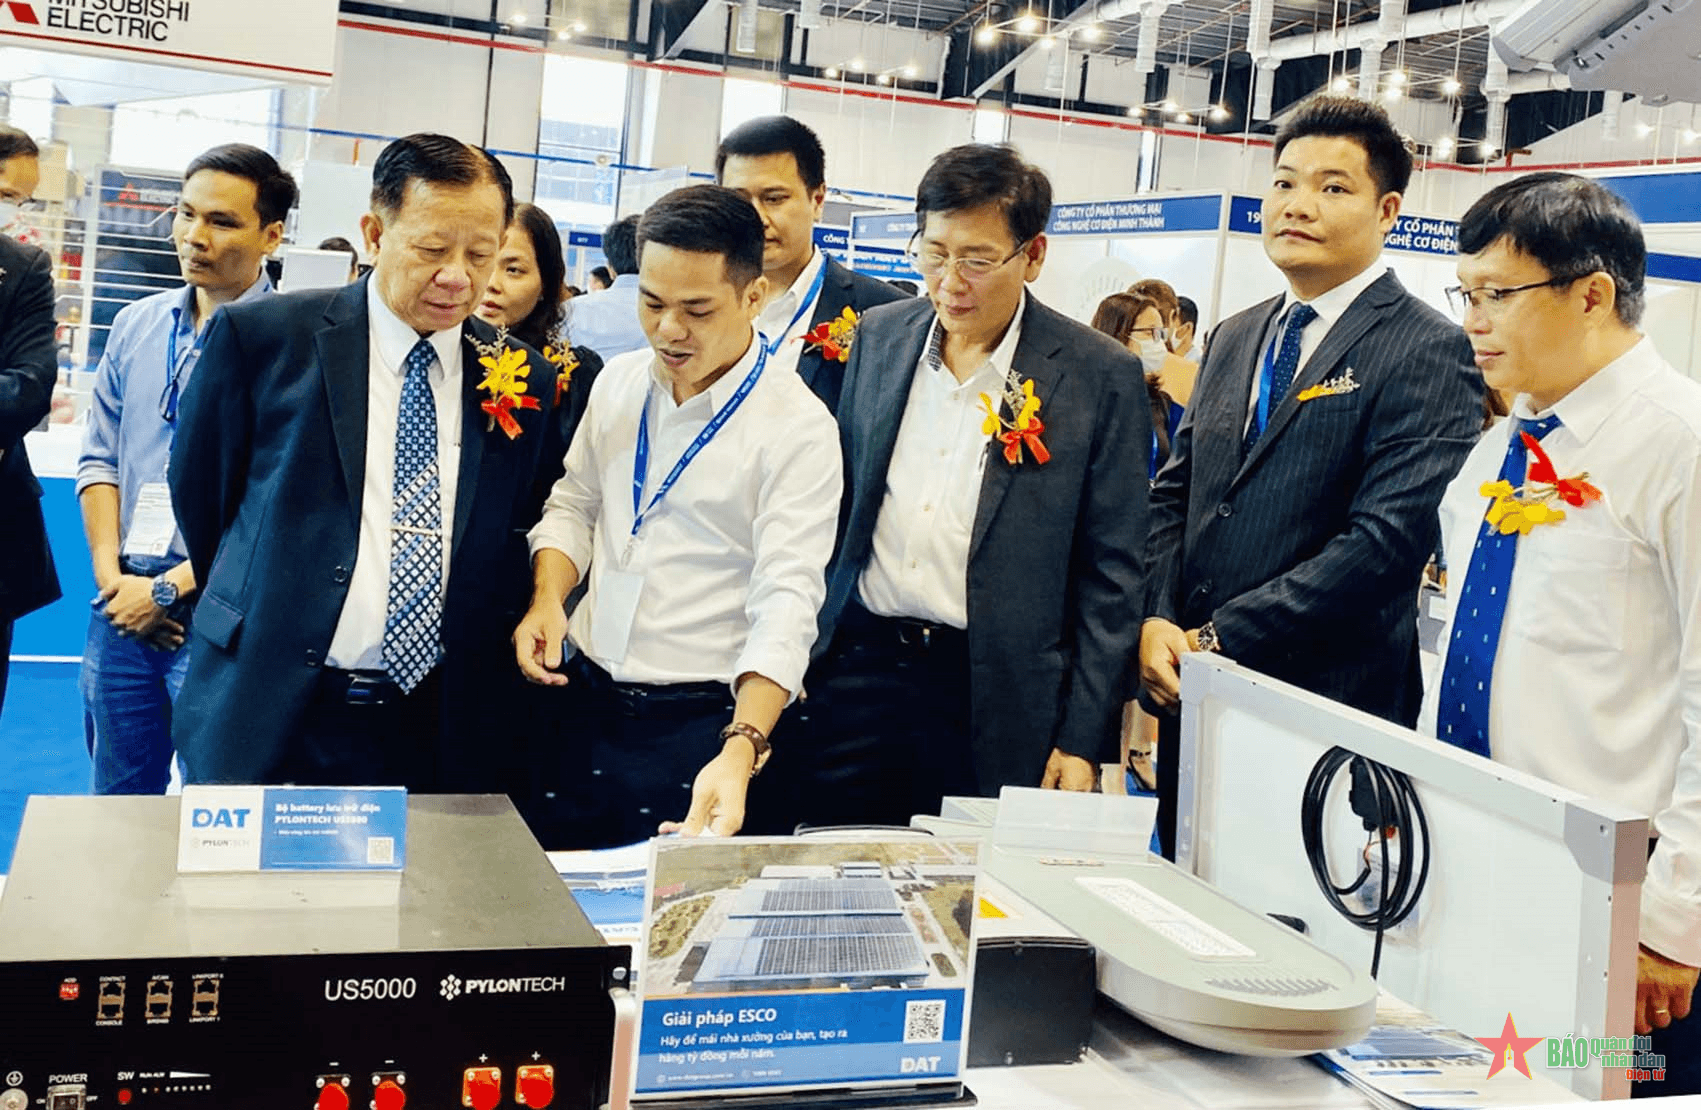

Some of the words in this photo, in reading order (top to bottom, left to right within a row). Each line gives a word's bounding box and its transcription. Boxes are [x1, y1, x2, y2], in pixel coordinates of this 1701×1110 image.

[47, 7, 168, 41] ELECTRIC
[1404, 218, 1421, 233] CỔ
[1422, 221, 1454, 236] PHẦN
[1413, 236, 1431, 248] CƠ
[290, 803, 325, 814] battery
[192, 808, 250, 828] DAT
[275, 815, 331, 824] PYLONTECH
[325, 978, 417, 1001] US5000
[465, 976, 566, 994] PYLONTECH
[662, 1011, 692, 1026] Giải
[696, 1010, 734, 1028] pháp
[738, 1008, 777, 1023] ESCO
[902, 1056, 942, 1073] DAT
[49, 1074, 88, 1083] POWER
[117, 1071, 135, 1080] SW
